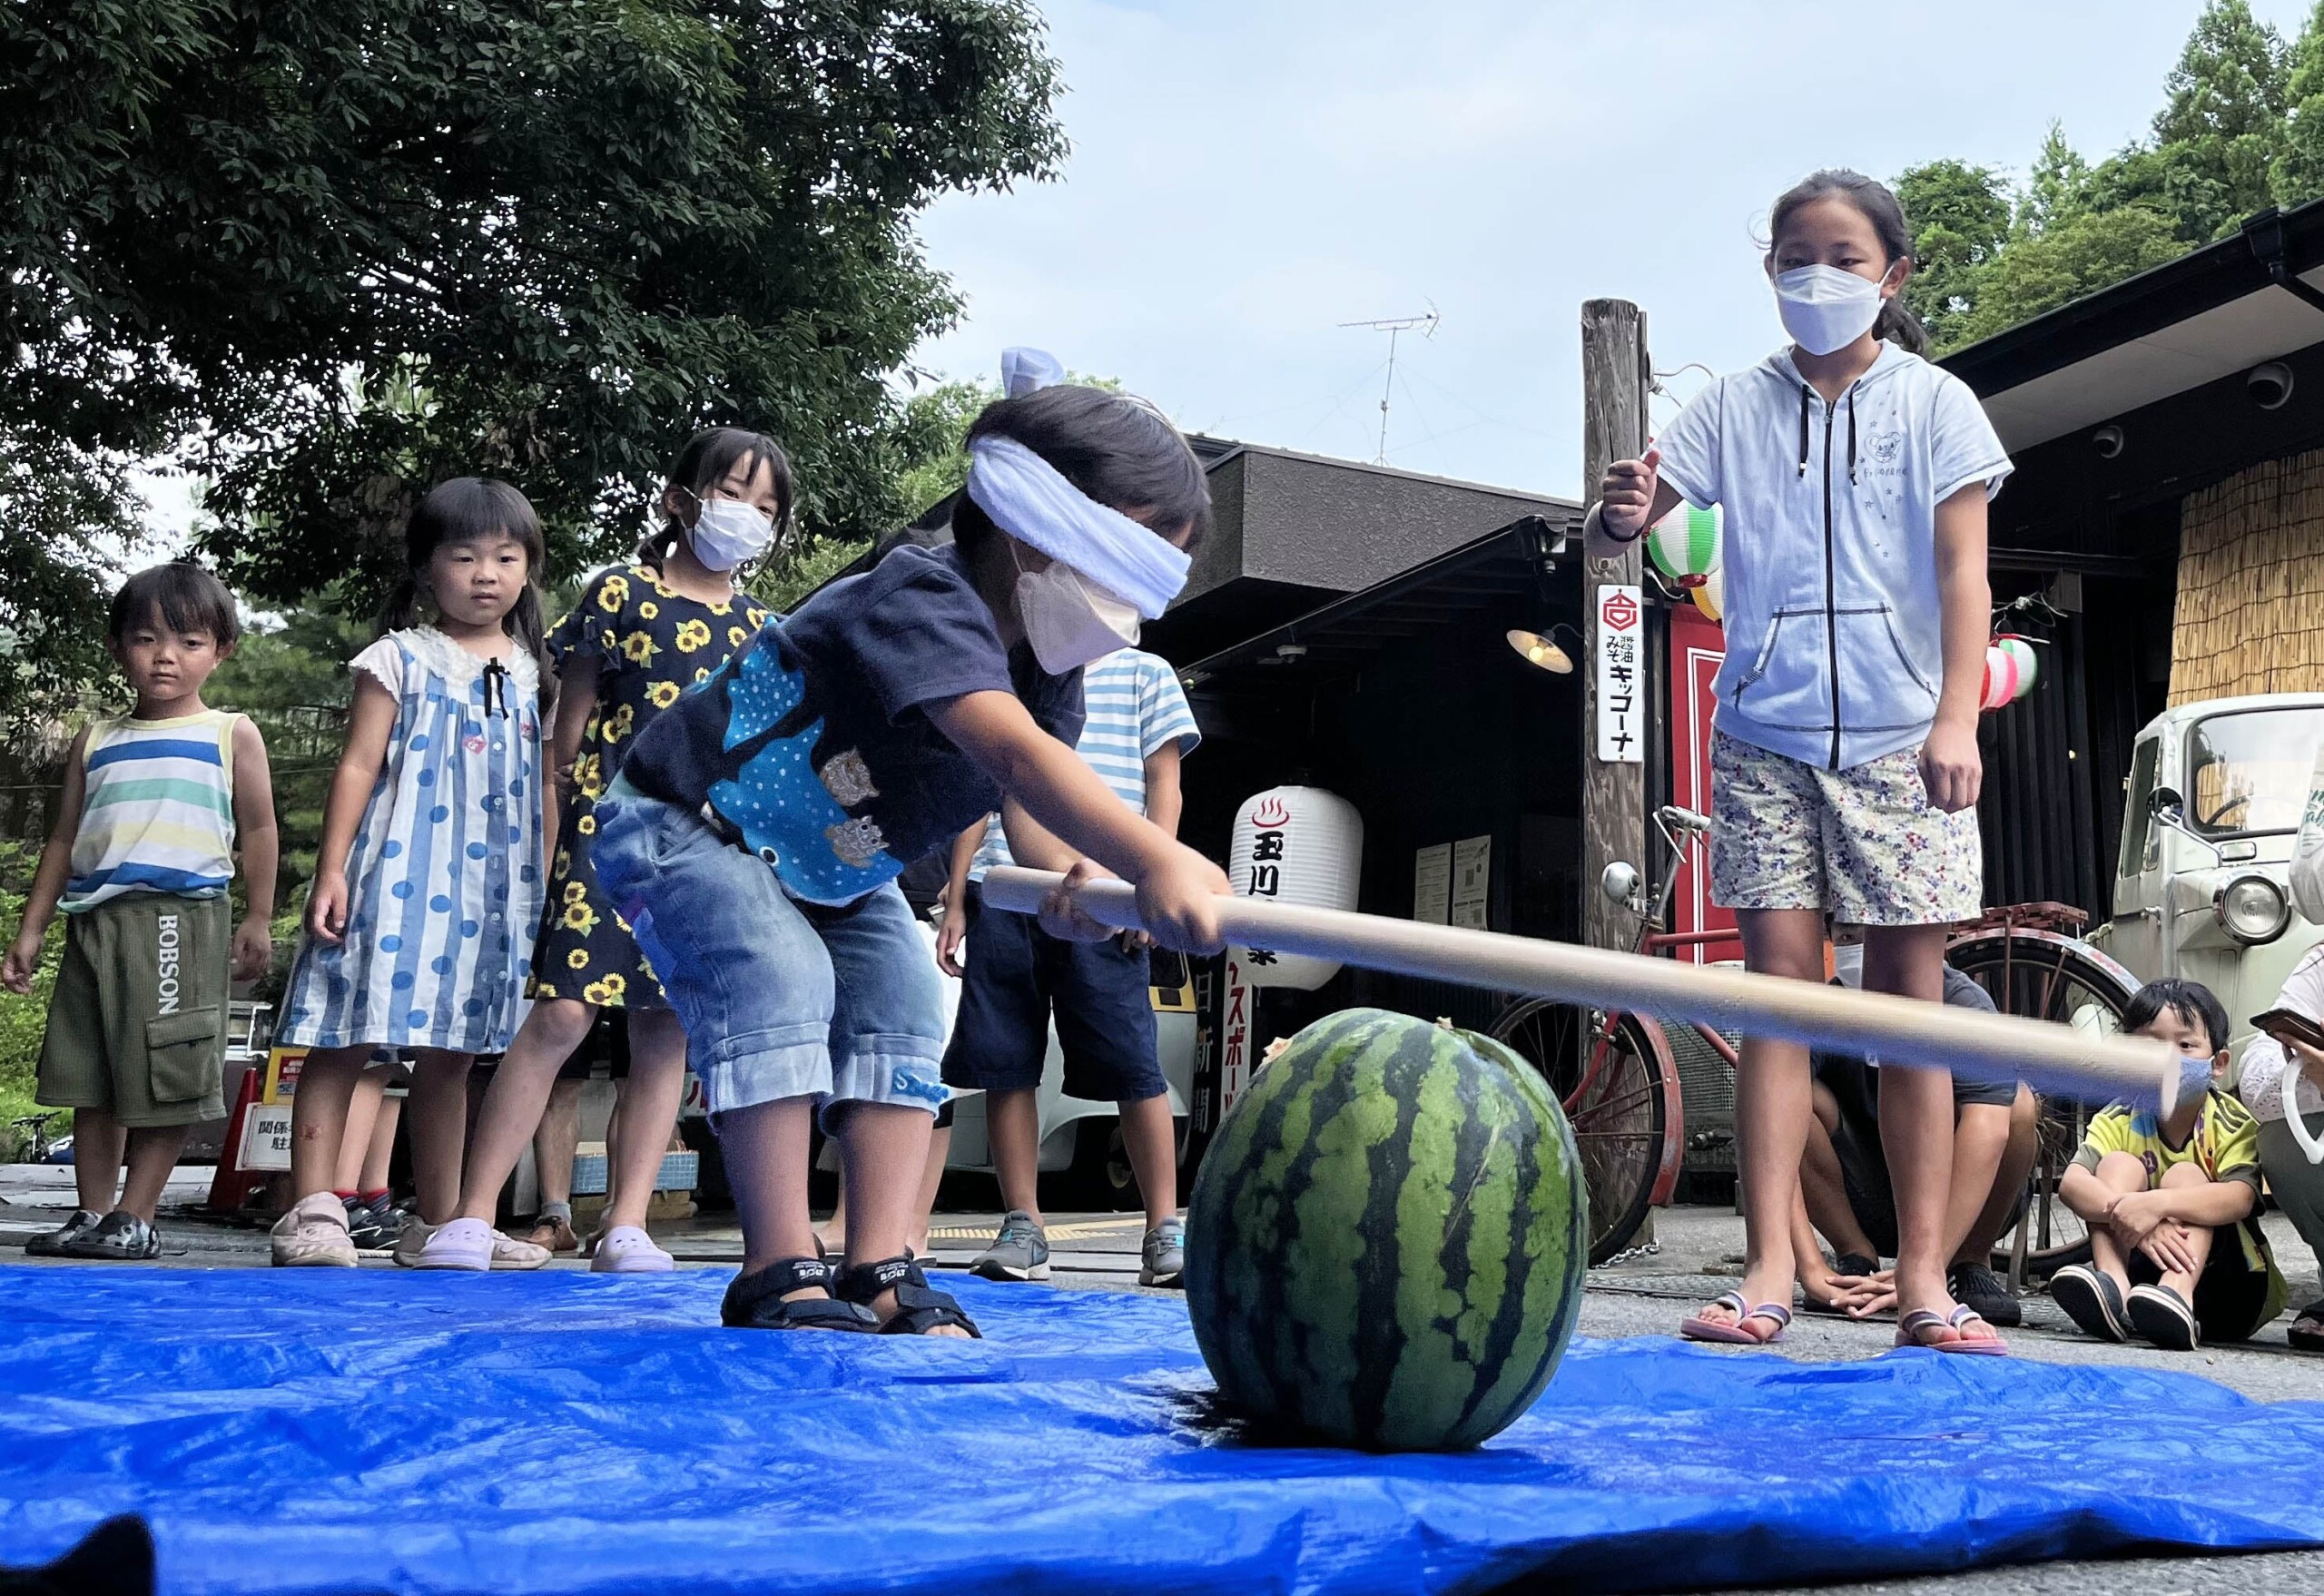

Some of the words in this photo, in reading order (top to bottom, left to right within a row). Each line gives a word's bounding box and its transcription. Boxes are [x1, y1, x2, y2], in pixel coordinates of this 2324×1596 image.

[1606, 635, 1620, 663] みそ
[1610, 665, 1633, 753] キッコーナ
[158, 915, 180, 1015] BOBSON
[1194, 953, 1213, 1133] 日新聞
[258, 1120, 291, 1135] 関係
[271, 1136, 291, 1150] 駐
